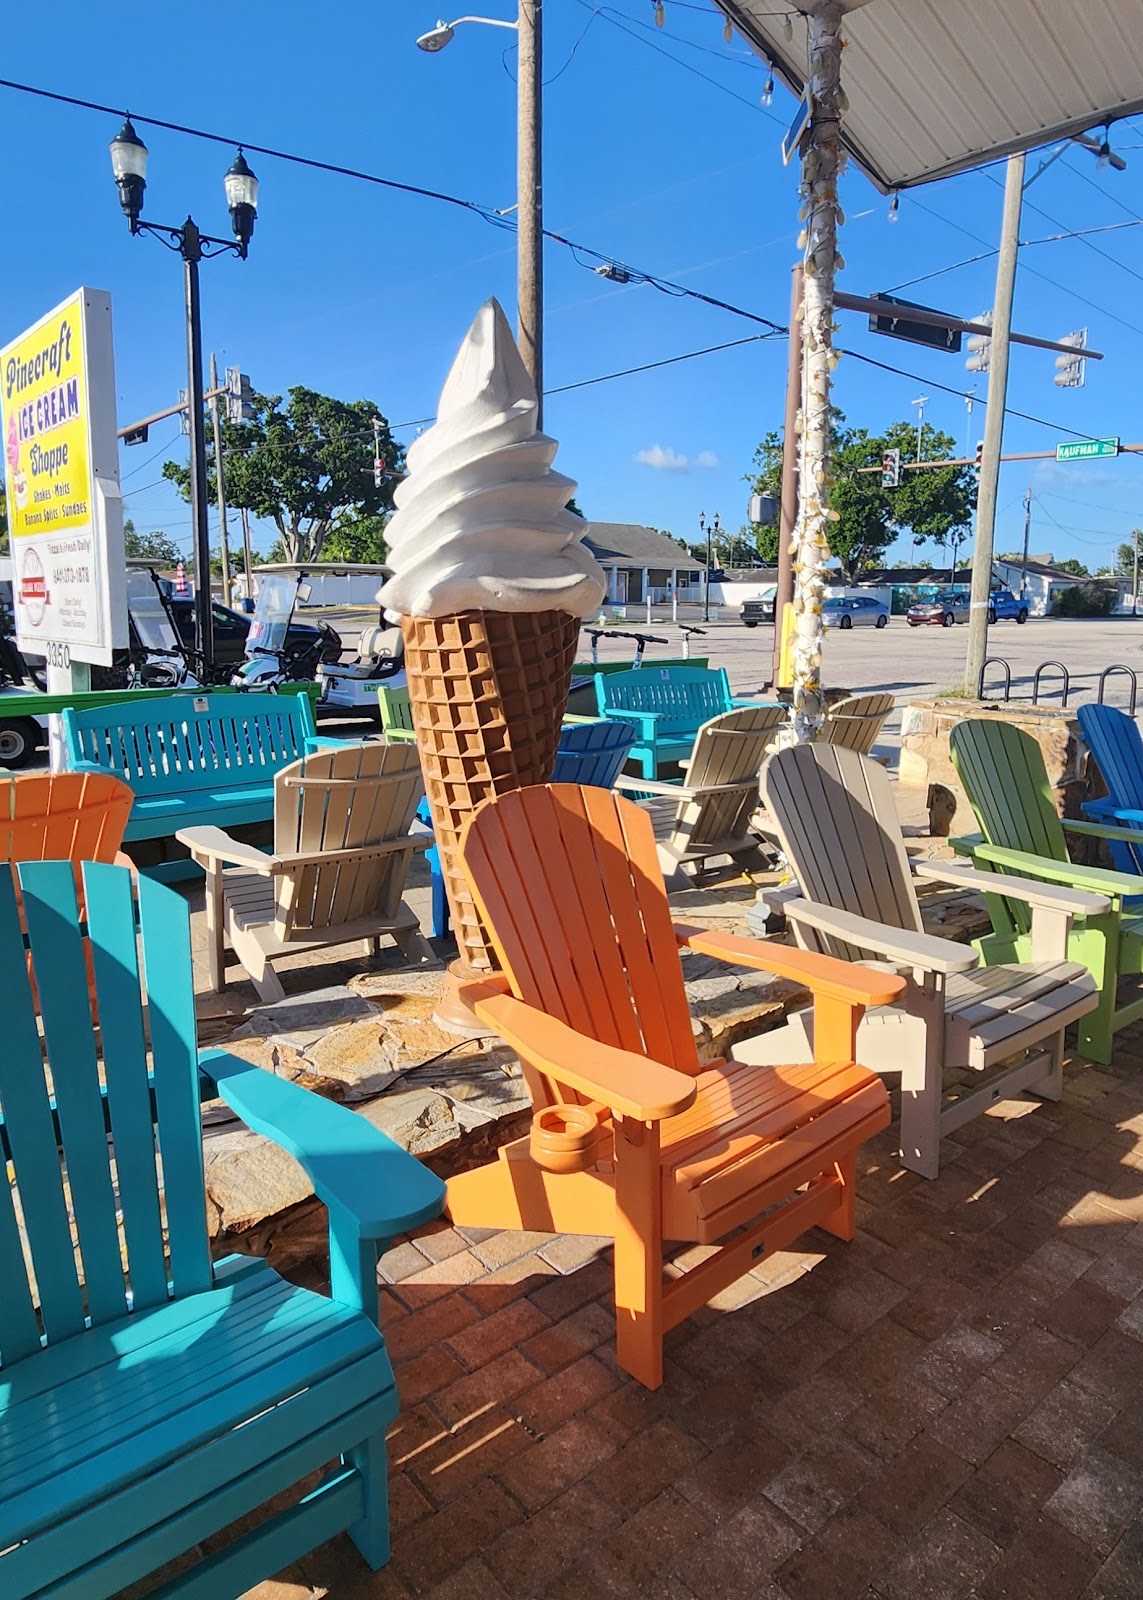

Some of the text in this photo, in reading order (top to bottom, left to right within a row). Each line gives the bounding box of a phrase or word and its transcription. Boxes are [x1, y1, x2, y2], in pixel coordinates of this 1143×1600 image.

[6, 320, 73, 400] Pinecraft
[18, 377, 79, 442] ICE CREAM
[29, 443, 69, 478] Shoppe
[1059, 443, 1099, 458] KAUFMAN
[33, 482, 71, 503] Shakes Malts
[24, 502, 87, 526] Banana Splits Sundaes
[46, 641, 71, 670] 3350
